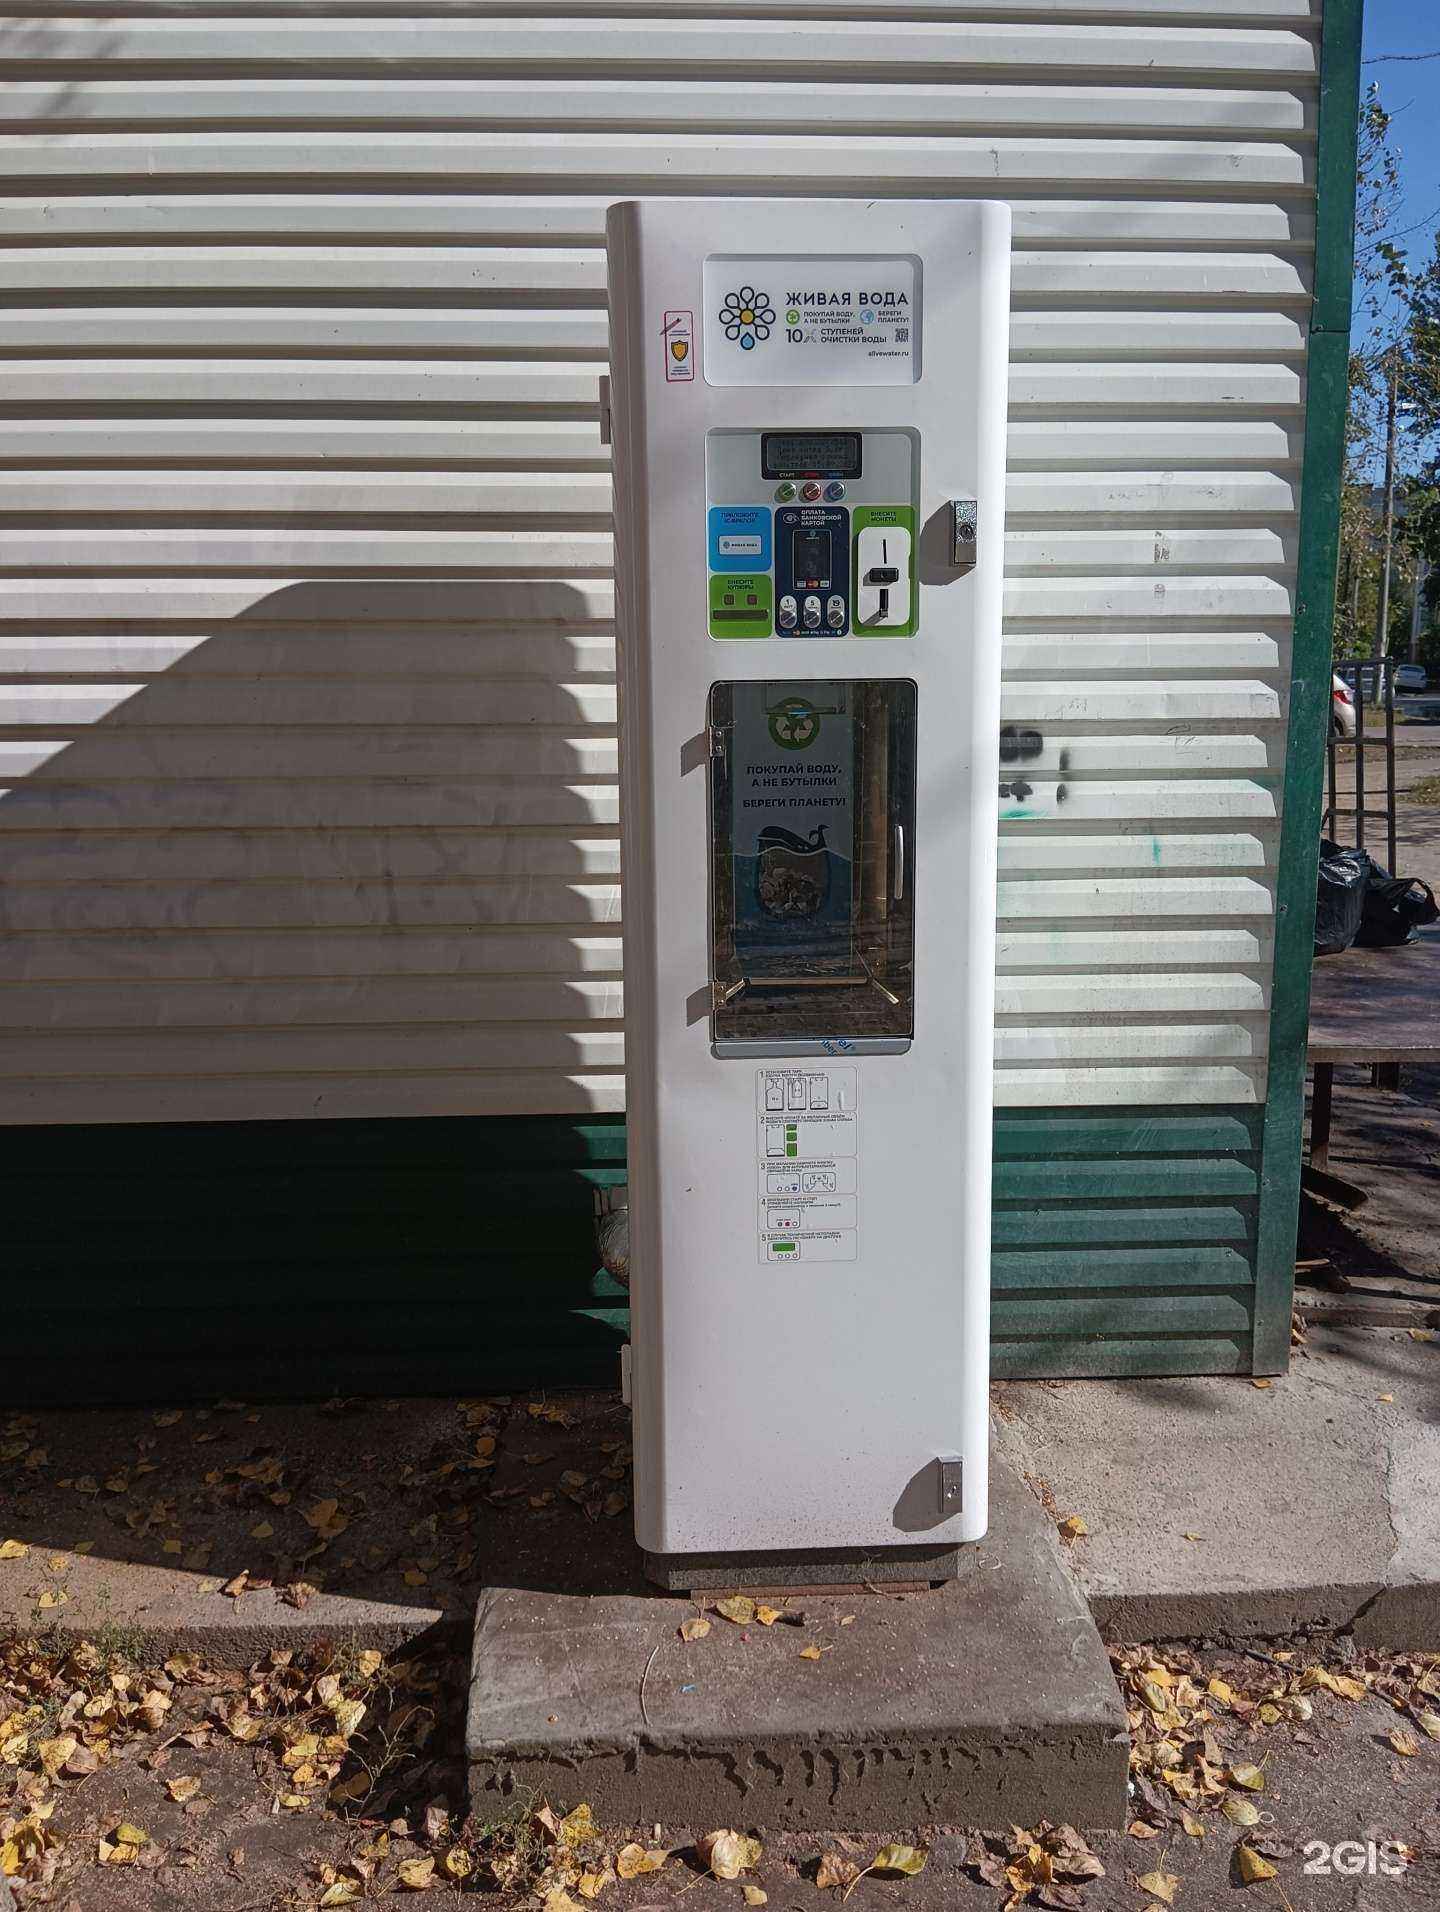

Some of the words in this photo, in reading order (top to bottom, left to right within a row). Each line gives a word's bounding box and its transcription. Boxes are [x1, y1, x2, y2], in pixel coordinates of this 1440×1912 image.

[785, 292, 851, 306] ЖИВАЯ
[858, 292, 909, 308] ВОДА
[803, 310, 835, 318] ПОКУПАЙ
[785, 328, 804, 343] 10
[820, 327, 864, 335] СТУПЕНЕЙ
[861, 336, 887, 344] ВОДЫ
[747, 763, 804, 775] ПОКУПАЙ
[806, 764, 842, 775] ВОДУ,
[751, 778, 760, 787] А
[763, 778, 780, 787] НЕ
[781, 777, 837, 787] БУТЫЛКИ
[742, 798, 786, 808] БЕРЕГИ
[789, 797, 846, 807] ПЛАНЕТУ!
[760, 1162, 766, 1170] 3
[761, 1233, 767, 1241] 5
